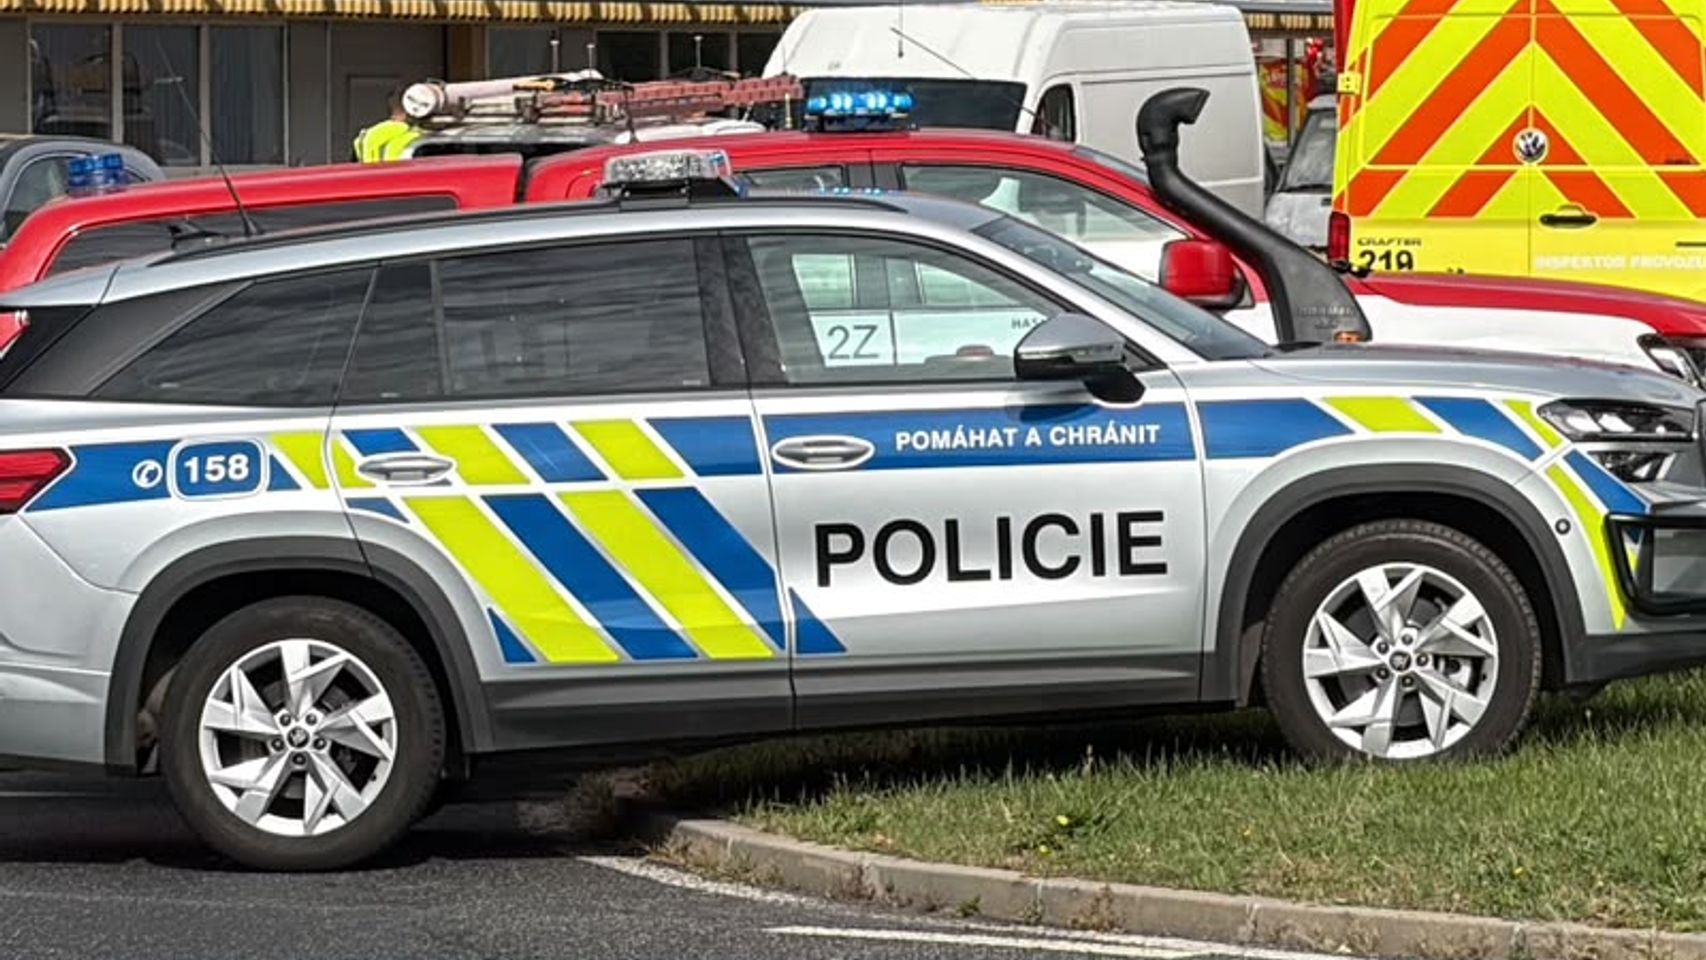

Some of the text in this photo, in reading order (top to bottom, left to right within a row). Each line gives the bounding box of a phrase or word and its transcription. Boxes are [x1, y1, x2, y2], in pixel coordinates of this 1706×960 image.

[1359, 249, 1414, 270] 219
[827, 324, 879, 360] 2Z
[895, 420, 1161, 451] POMÁHAT A CHRÁNIT
[183, 453, 249, 484] 158
[815, 510, 1168, 588] POLICIE
